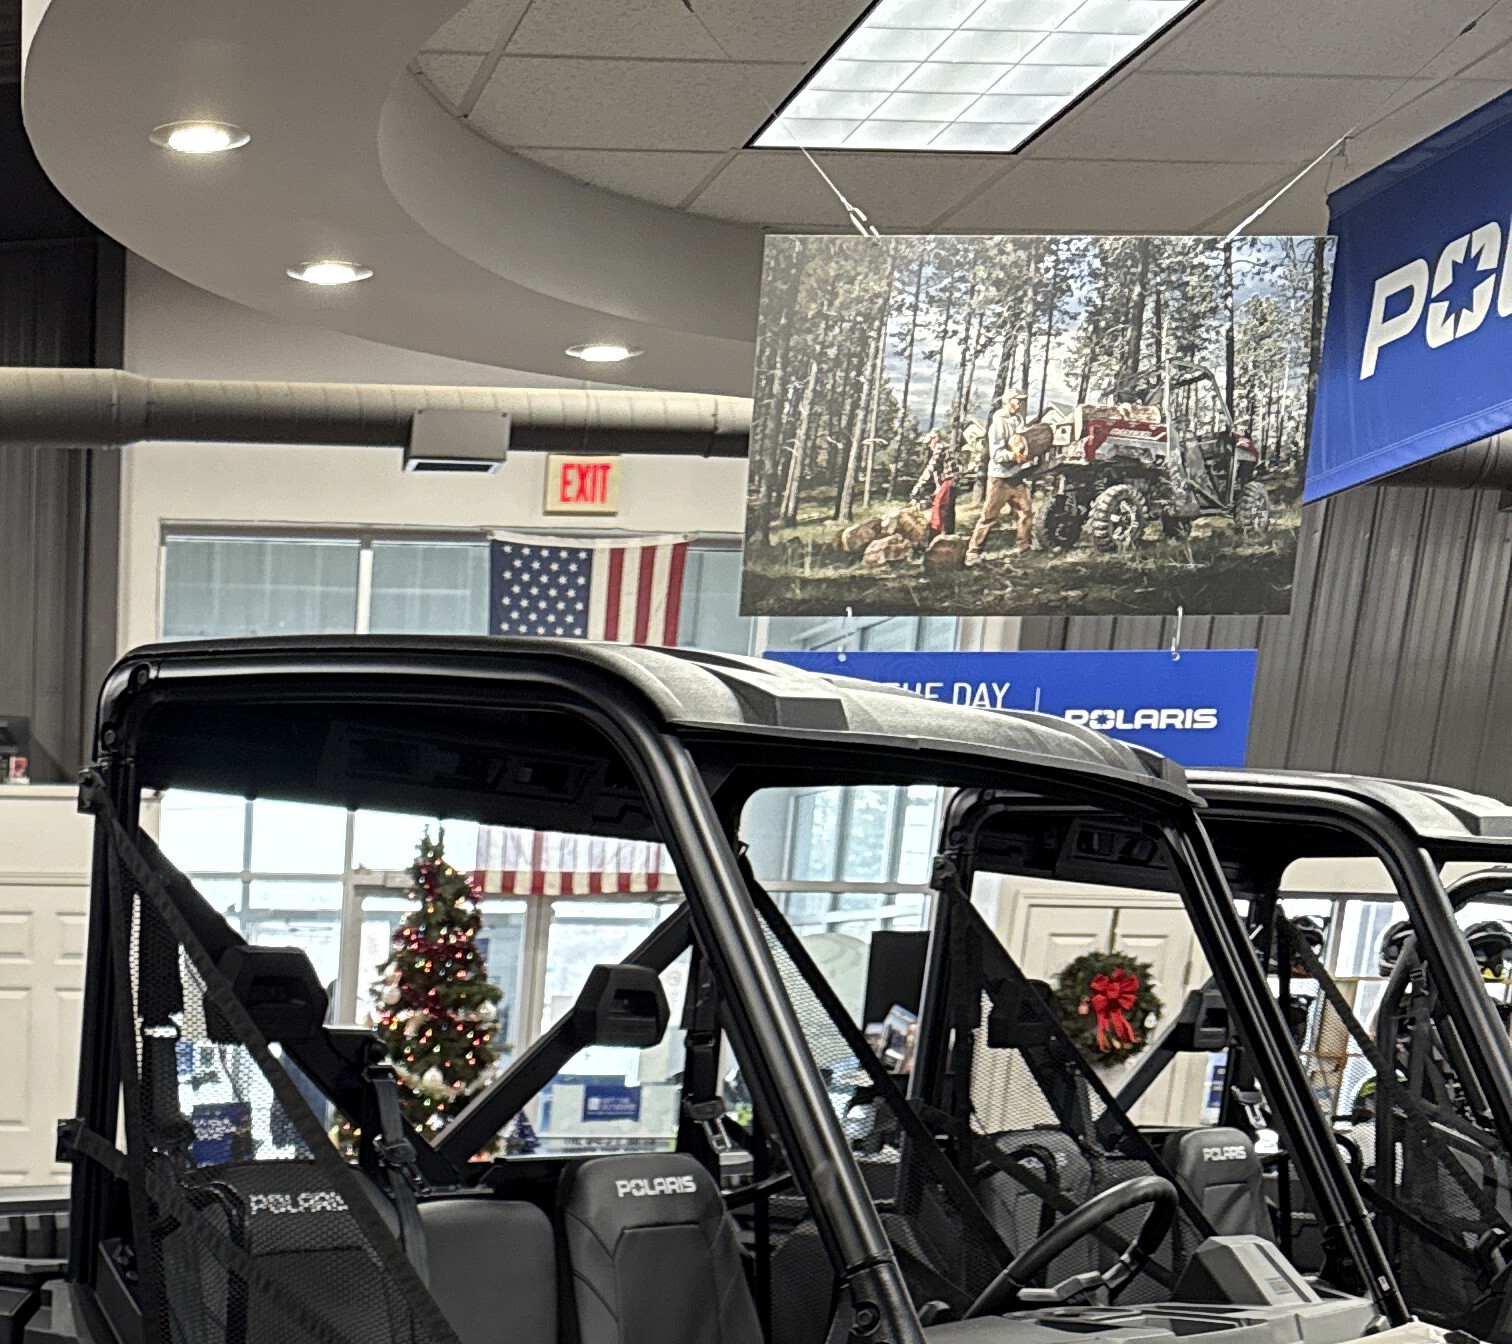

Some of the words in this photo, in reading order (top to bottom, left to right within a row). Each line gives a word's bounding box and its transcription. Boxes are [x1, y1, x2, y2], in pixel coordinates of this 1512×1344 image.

[560, 463, 611, 503] EXIT
[953, 682, 1011, 708] DAY
[1064, 708, 1218, 729] POLARIS
[1203, 1146, 1247, 1161] POLARIS
[616, 1175, 696, 1197] POLARIS
